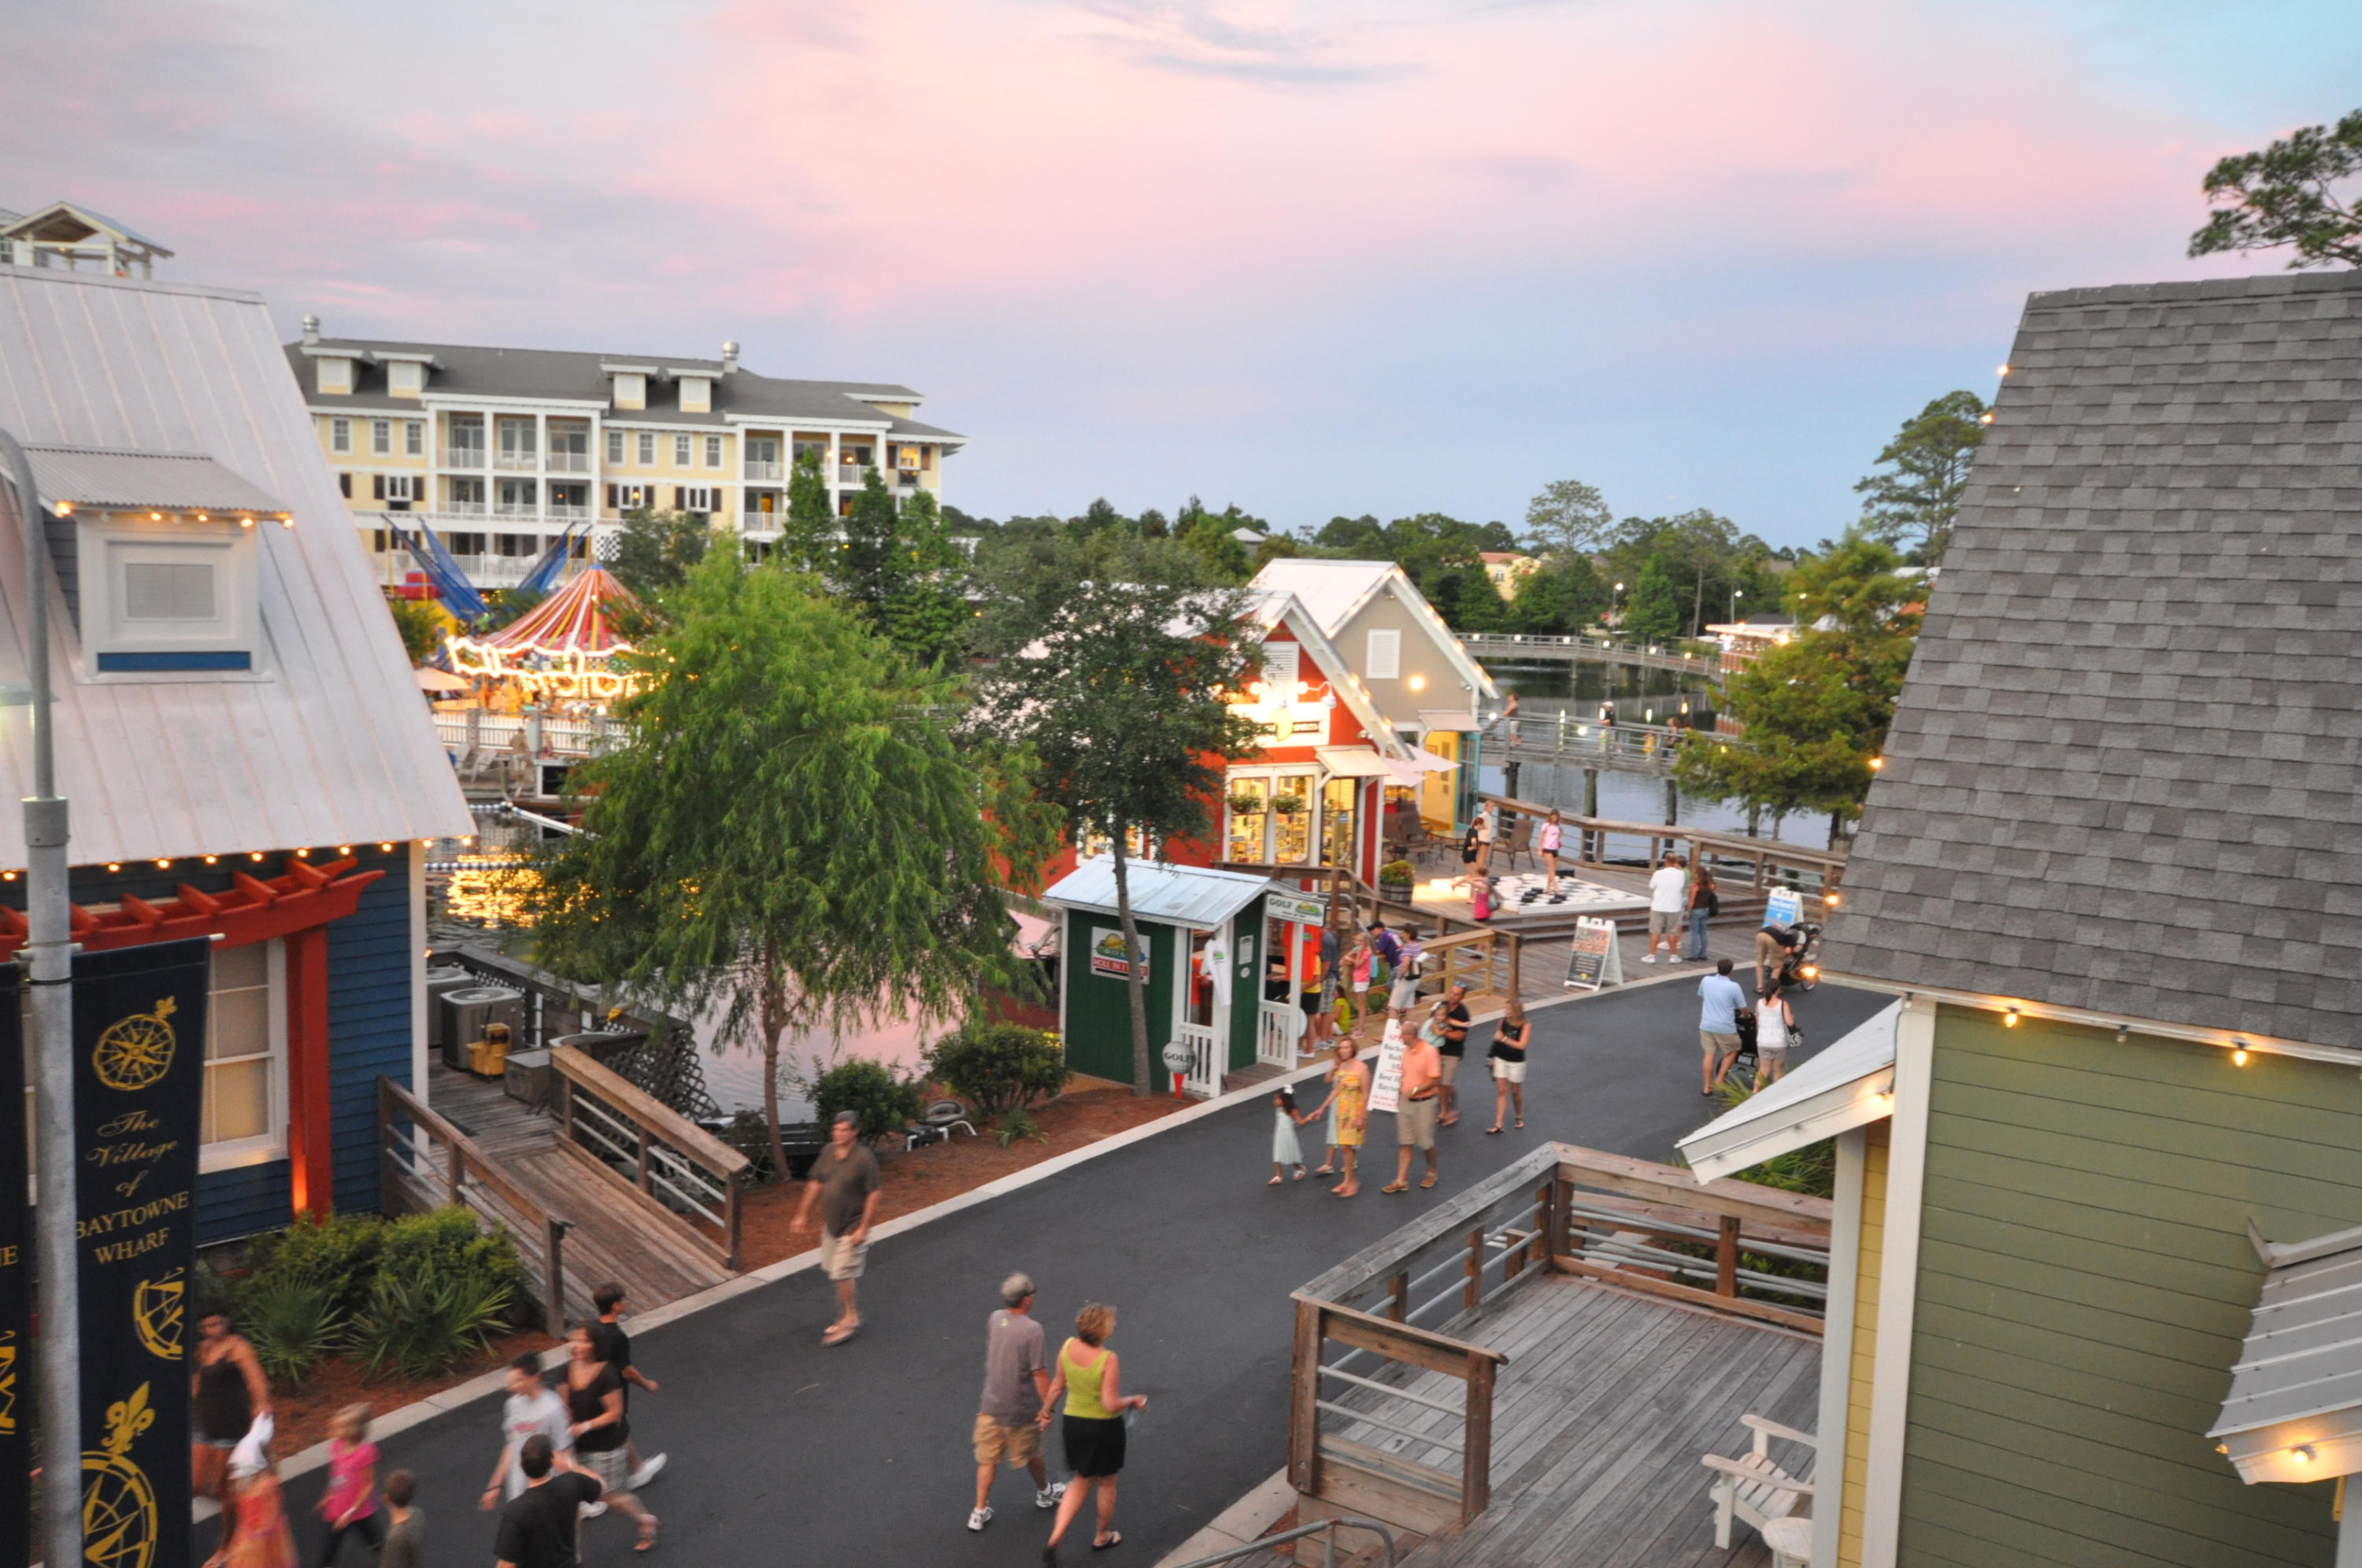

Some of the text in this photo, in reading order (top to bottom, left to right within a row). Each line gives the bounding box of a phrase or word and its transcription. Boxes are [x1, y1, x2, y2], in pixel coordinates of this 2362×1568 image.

[1269, 898, 1292, 908] GOLF
[1165, 1052, 1195, 1063] GOLF
[97, 1111, 159, 1137] The
[85, 1141, 178, 1167] Village
[116, 1170, 149, 1197] of
[76, 1191, 189, 1240] BAYTOWNE
[94, 1227, 169, 1265] WHARF
